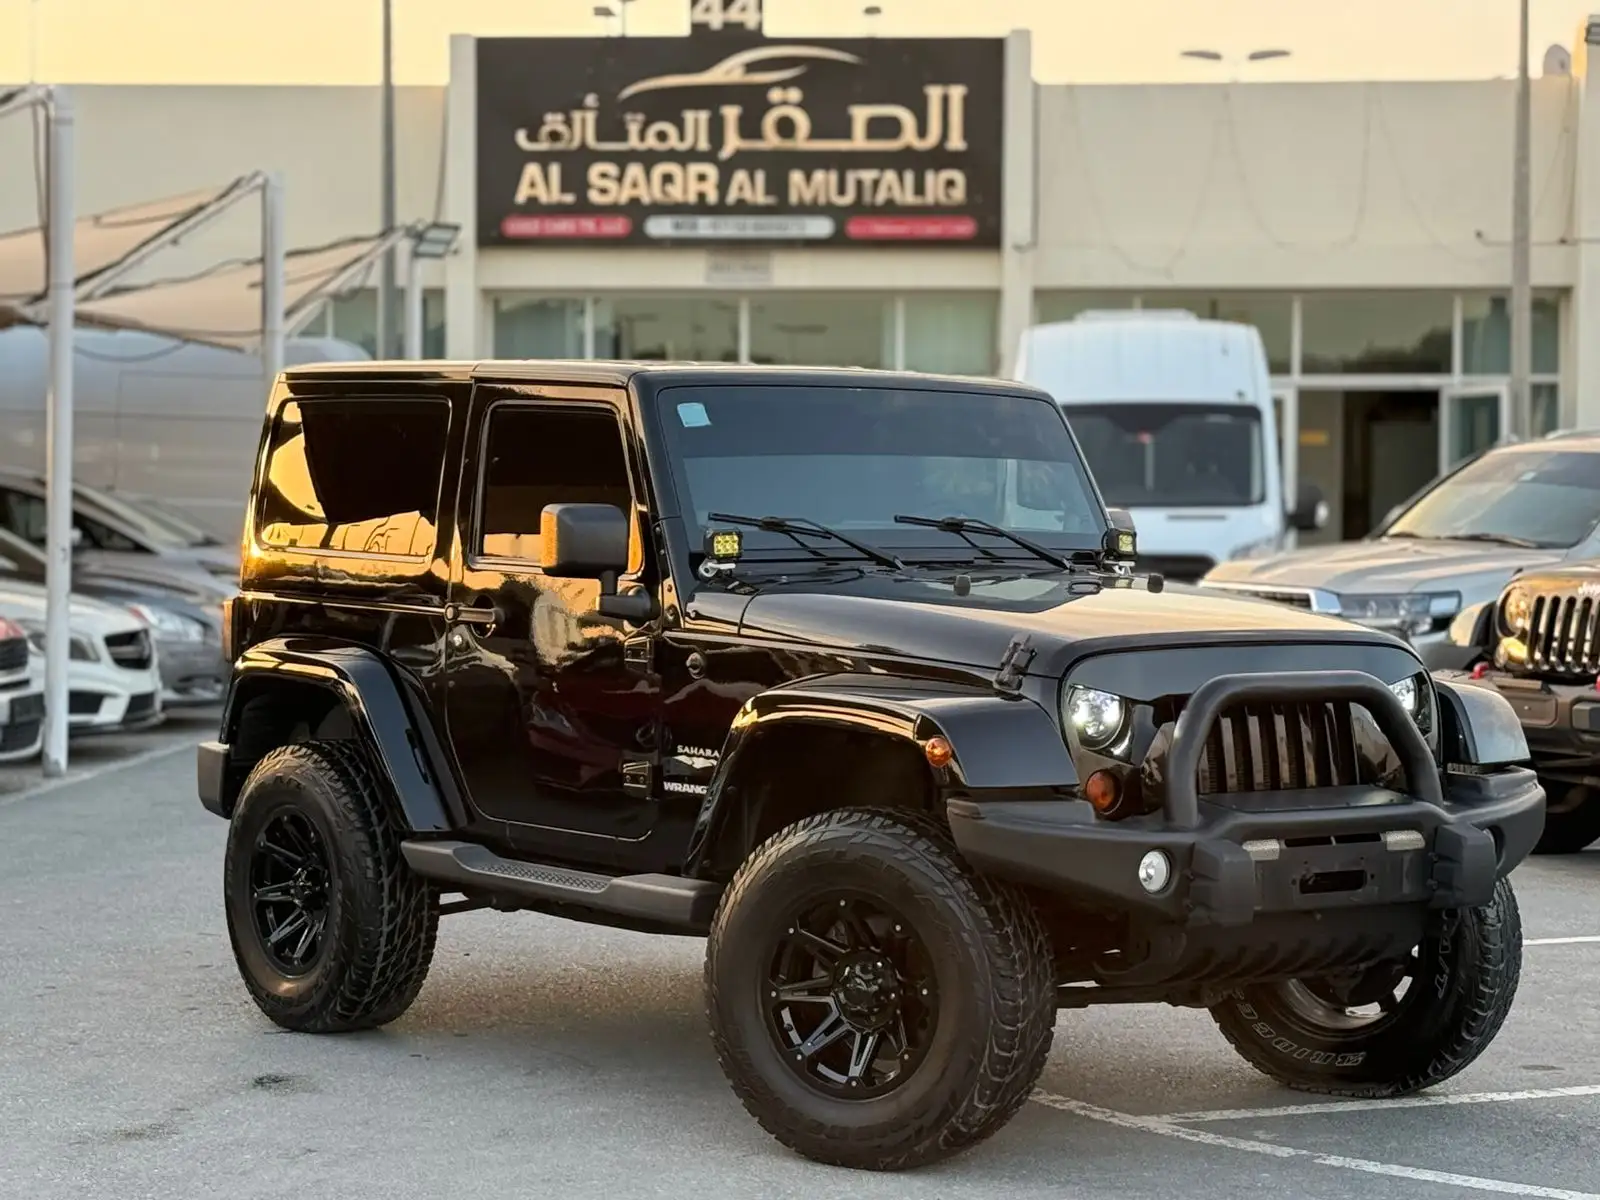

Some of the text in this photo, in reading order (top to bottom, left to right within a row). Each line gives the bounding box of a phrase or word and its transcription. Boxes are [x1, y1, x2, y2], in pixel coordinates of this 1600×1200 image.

[690, 0, 761, 31] 44
[718, 84, 968, 160] الصقر
[515, 162, 967, 206] AL SAQR AL MUTALIQ
[677, 744, 720, 758] SAHARA
